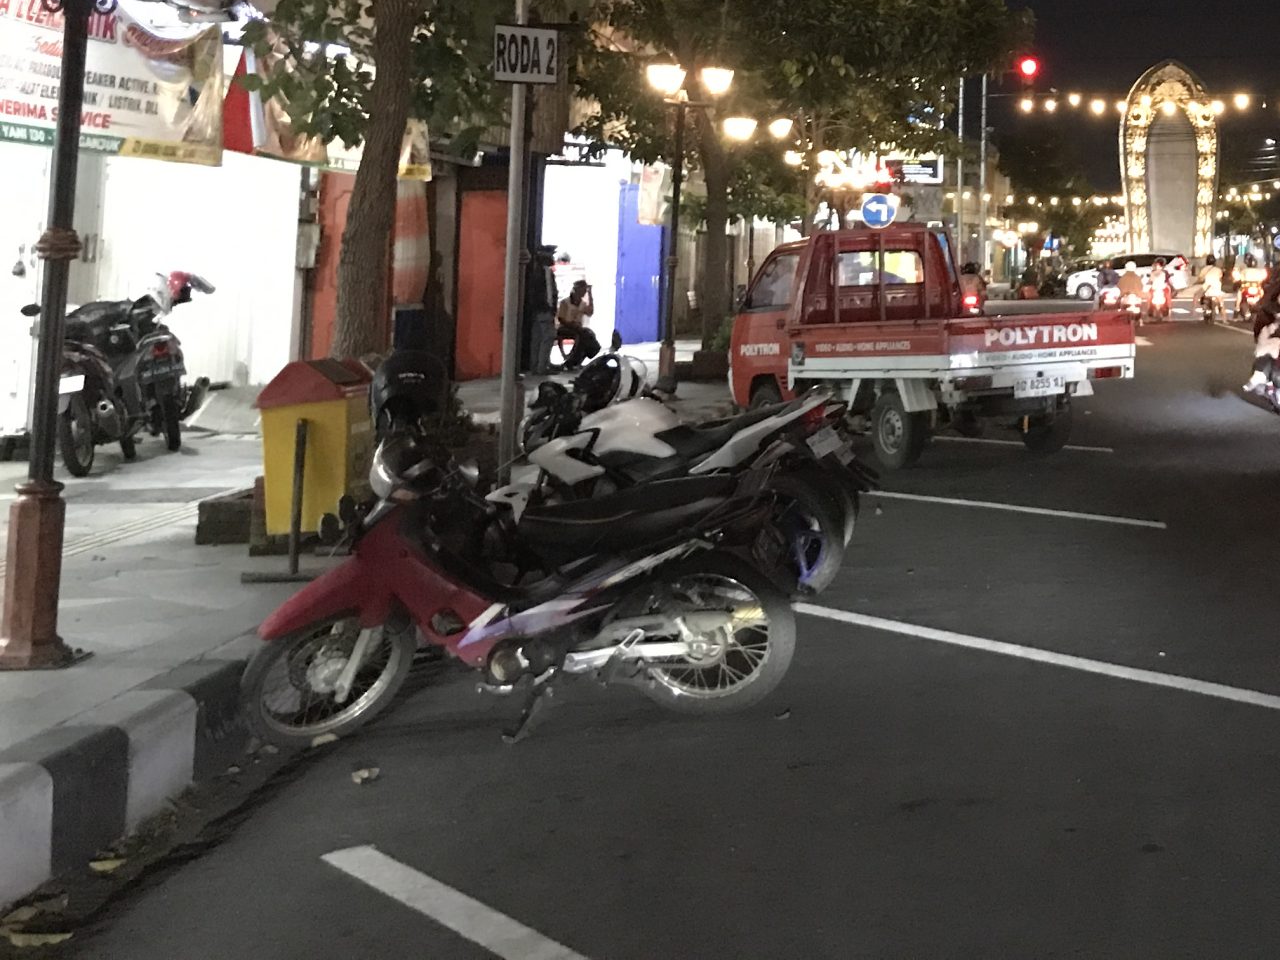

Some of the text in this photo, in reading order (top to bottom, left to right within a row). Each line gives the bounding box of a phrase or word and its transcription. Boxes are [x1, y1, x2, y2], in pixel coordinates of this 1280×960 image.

[496, 33, 556, 75] RODA 2
[51, 106, 111, 129] SVICE
[984, 323, 1098, 347] POLYTRON
[740, 342, 780, 356] POLYTRON
[1058, 349, 1097, 357] APPLIANCES
